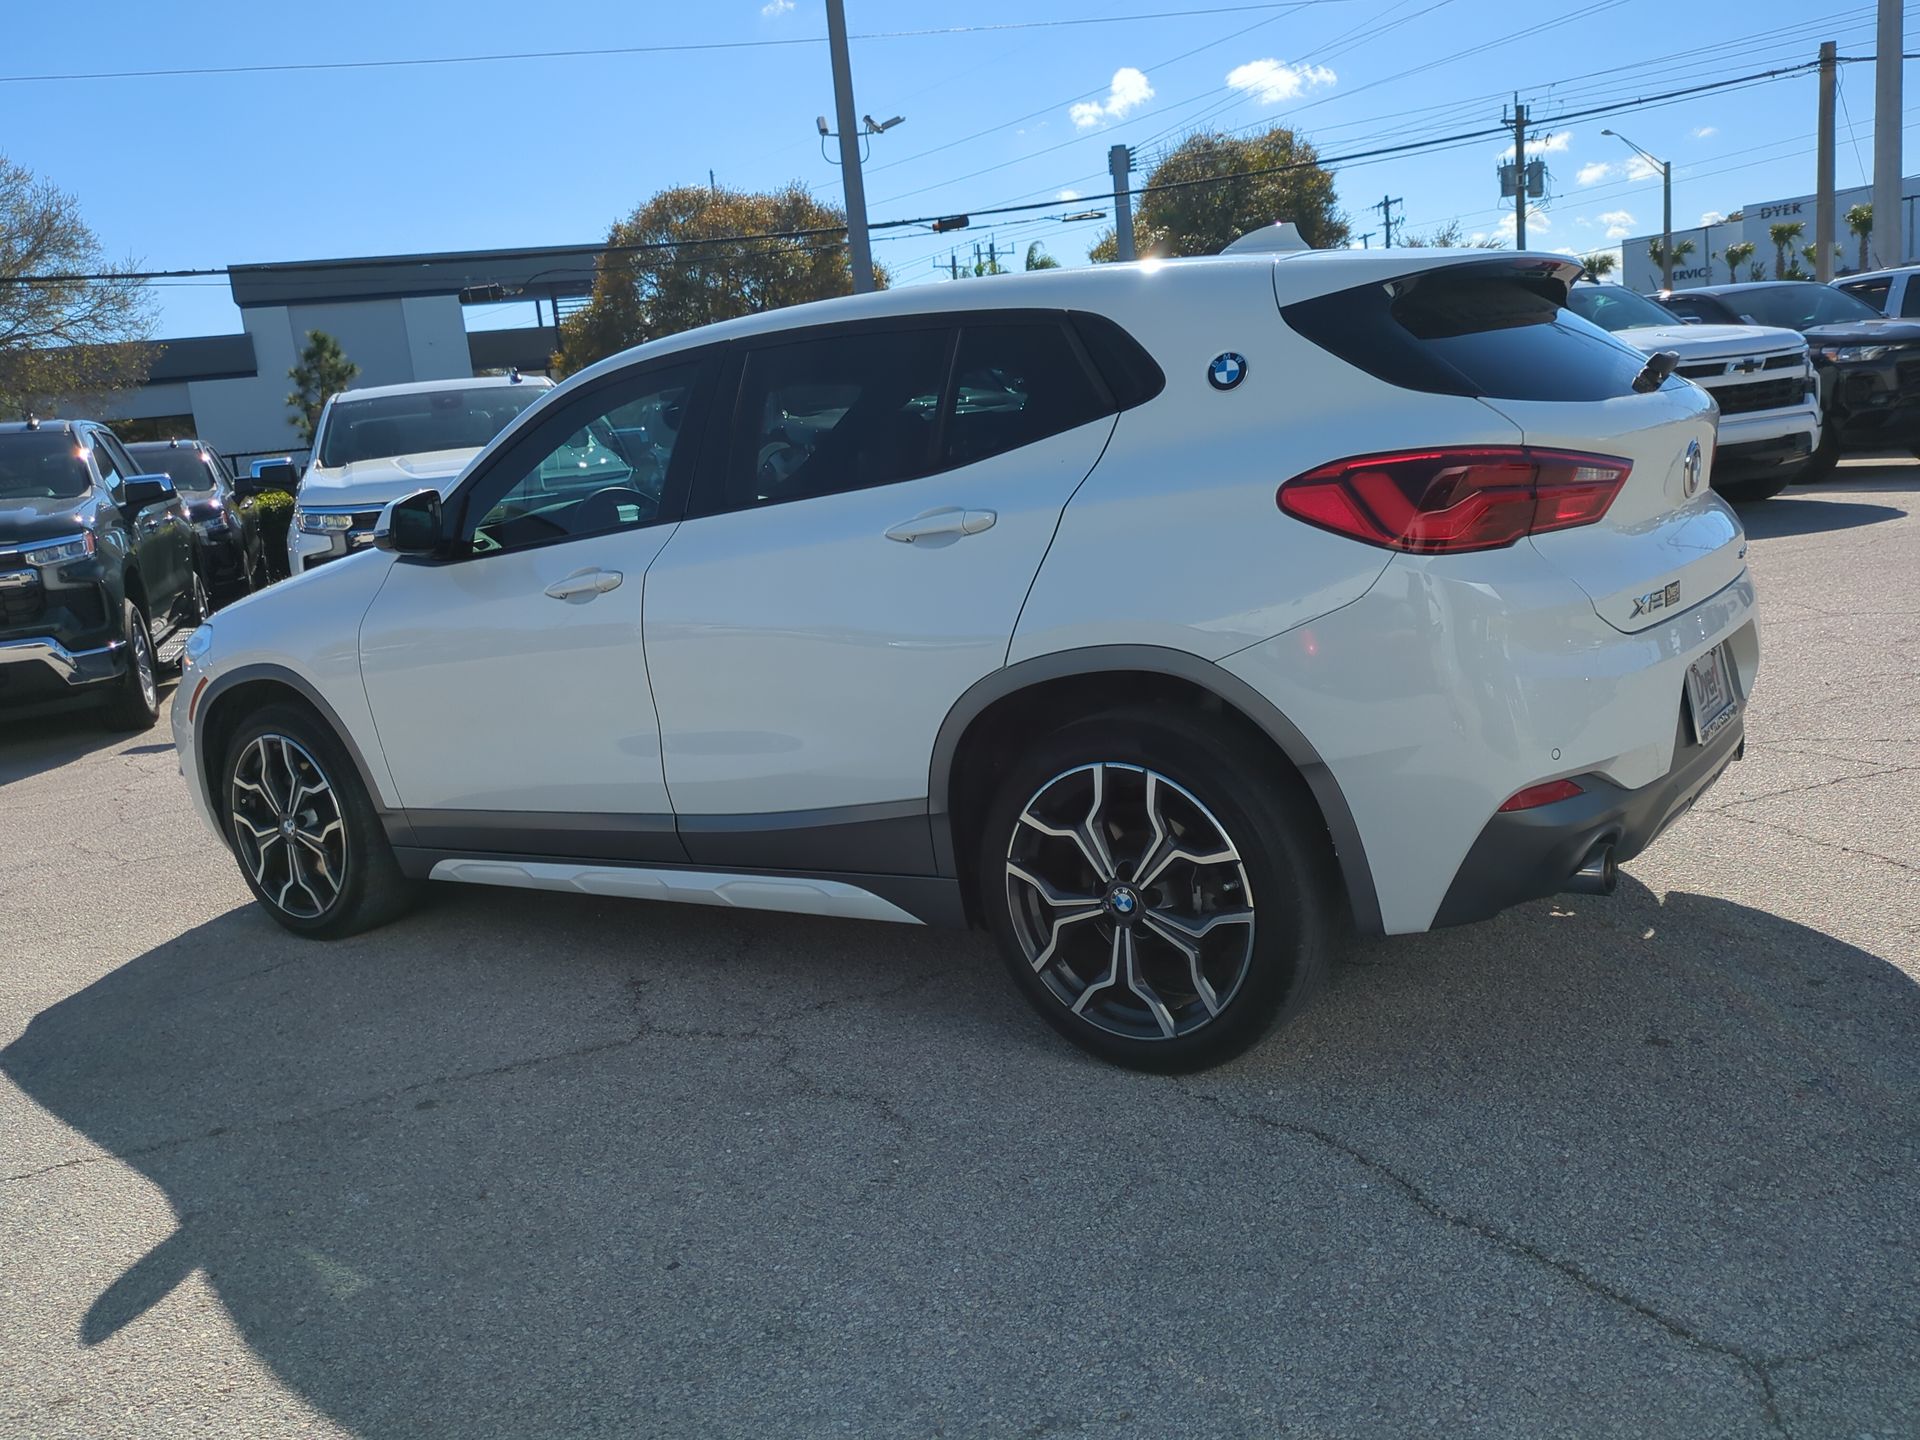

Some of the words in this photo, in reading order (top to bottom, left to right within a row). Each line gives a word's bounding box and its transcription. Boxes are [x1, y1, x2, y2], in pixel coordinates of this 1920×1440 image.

[1761, 203, 1802, 219] DYER
[1661, 267, 1712, 281] ERVICE
[1210, 352, 1245, 368] BMW
